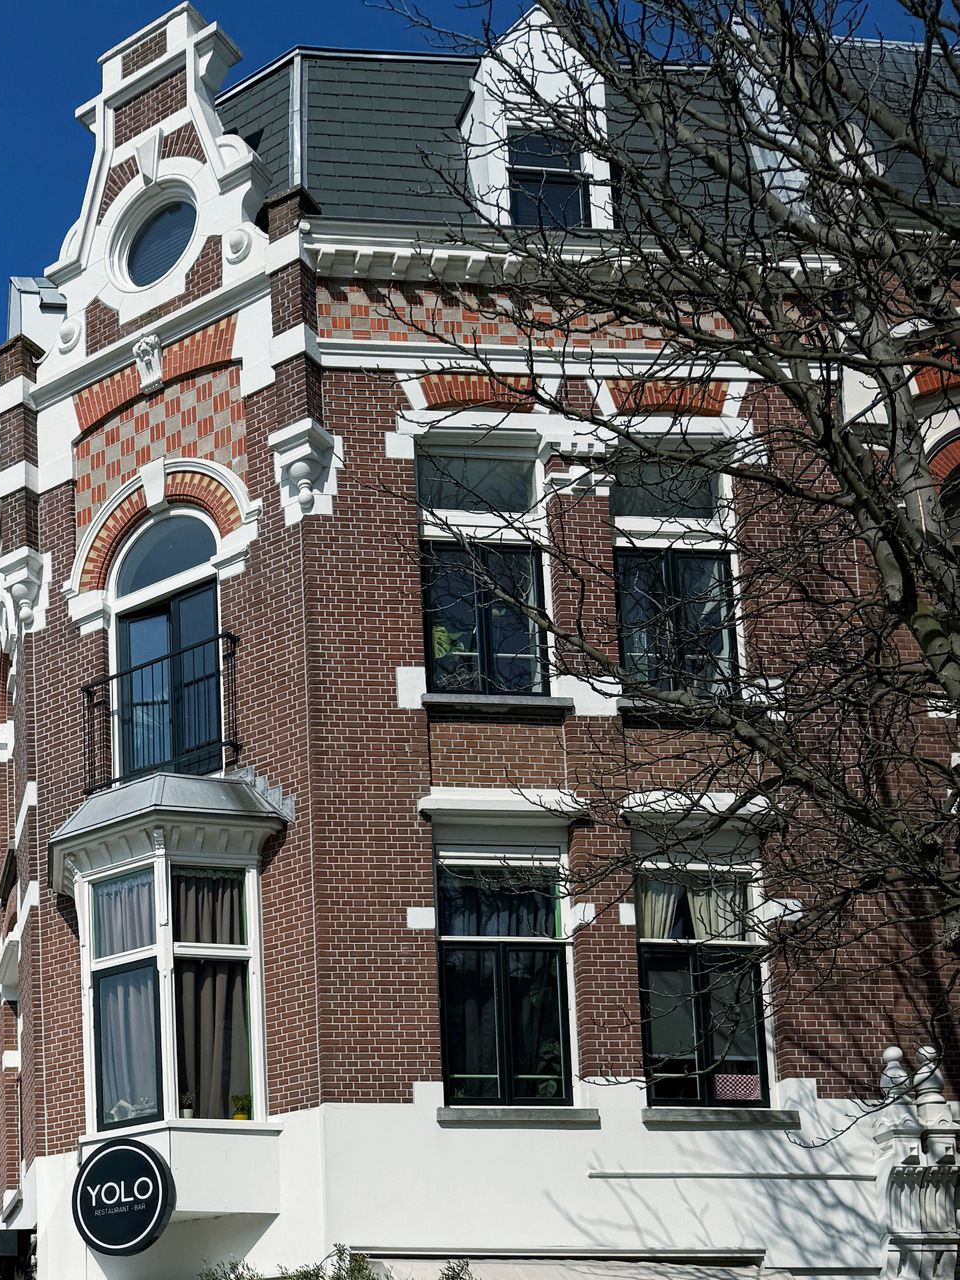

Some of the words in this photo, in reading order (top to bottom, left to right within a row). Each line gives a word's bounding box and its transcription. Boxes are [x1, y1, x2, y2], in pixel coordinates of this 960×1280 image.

[86, 1176, 153, 1207] YOLO
[94, 1205, 129, 1217] RESTAURANT
[134, 1202, 146, 1211] BAR
